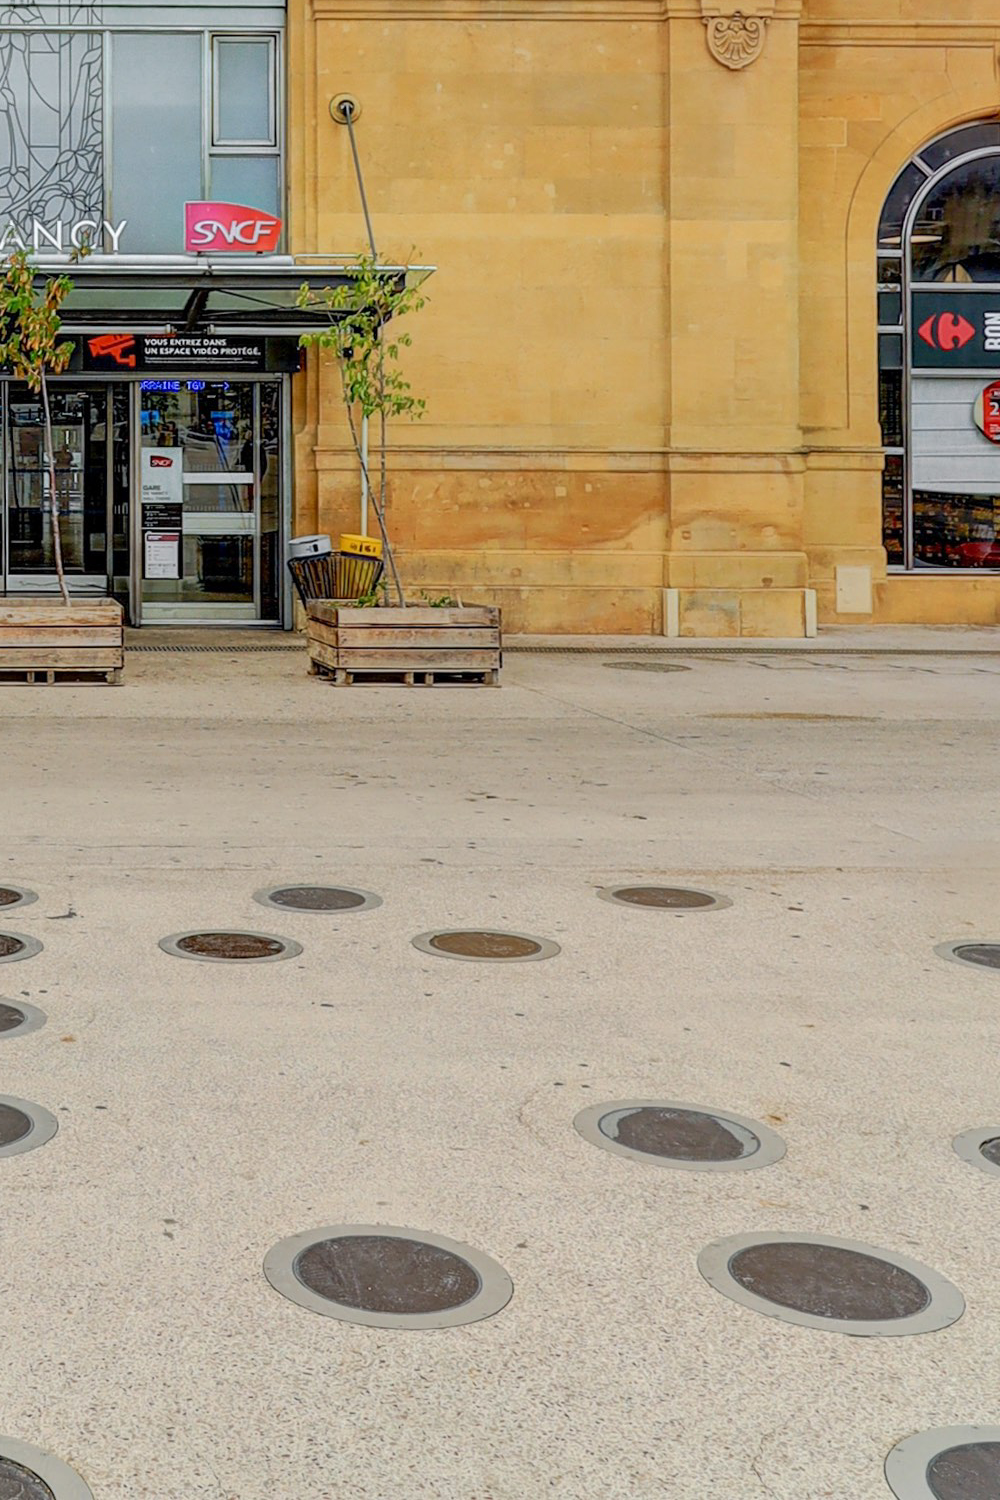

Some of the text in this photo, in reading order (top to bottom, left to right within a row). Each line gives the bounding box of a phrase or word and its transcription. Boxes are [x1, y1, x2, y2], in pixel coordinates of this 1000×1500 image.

[190, 220, 277, 245] SNCF
[144, 338, 227, 346] VOUS ENTREZ DANS
[144, 347, 158, 355] UN
[160, 347, 191, 355] ESPACE
[193, 346, 219, 355] VIDÉO
